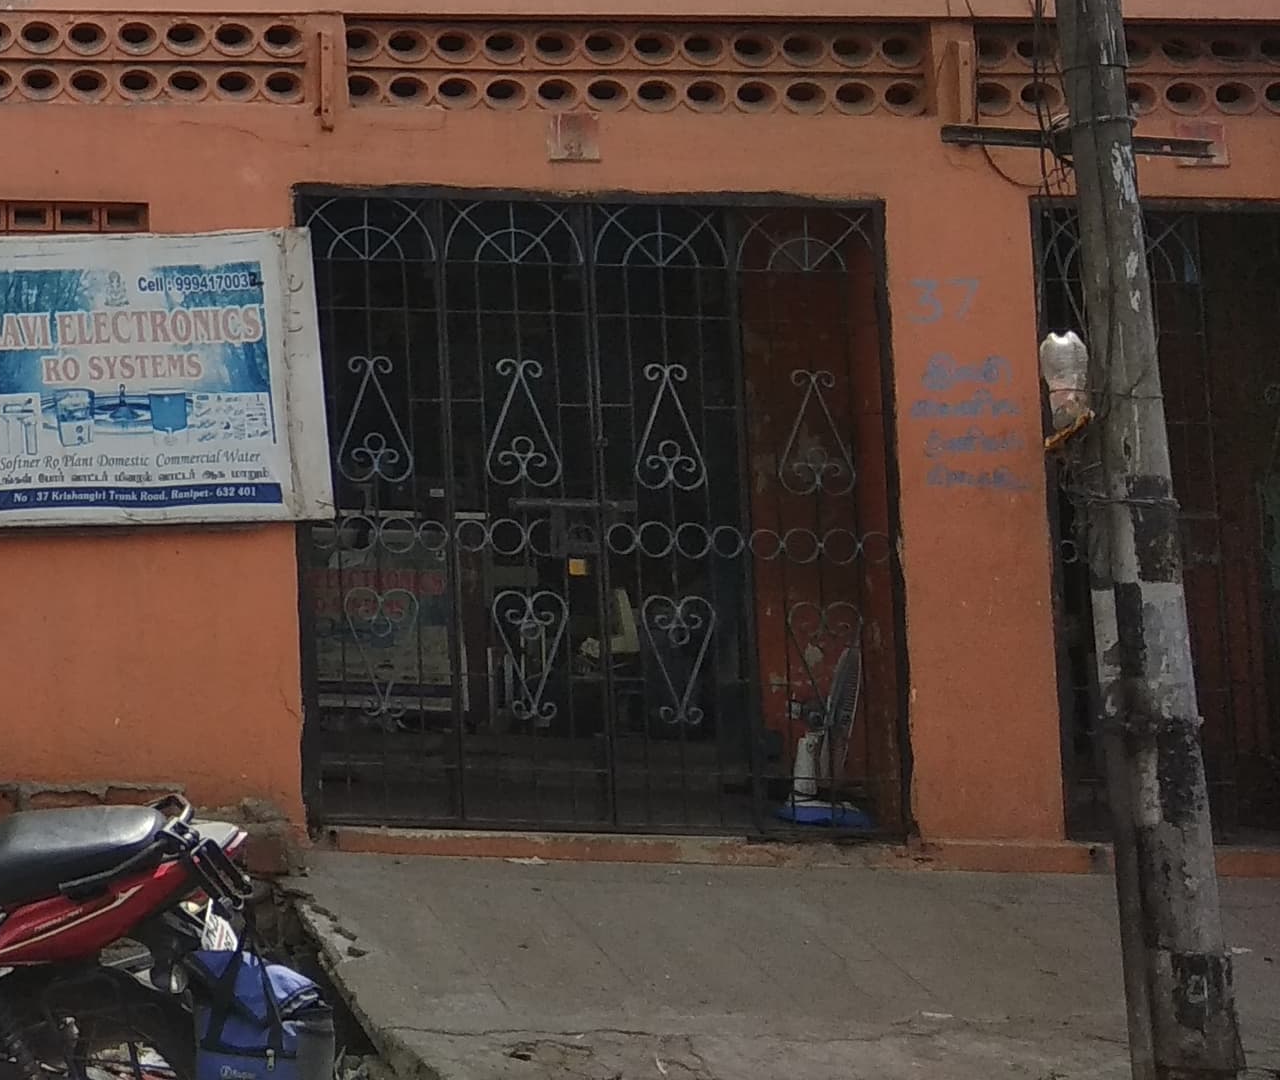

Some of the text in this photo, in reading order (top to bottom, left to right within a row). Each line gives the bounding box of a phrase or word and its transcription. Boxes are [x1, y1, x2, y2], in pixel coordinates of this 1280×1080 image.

[138, 276, 163, 292] Cell
[907, 277, 981, 324] 37
[56, 307, 263, 346] ELECTRONICS
[43, 353, 203, 382] RO SYSTEMS
[0, 455, 41, 473] Softner
[62, 453, 94, 468] Plant
[96, 454, 150, 468] Domestic
[155, 449, 221, 468] Commercial
[224, 448, 262, 463] Water
[36, 491, 49, 502] 37
[108, 490, 138, 501] Trunk
[215, 486, 236, 498] 632
